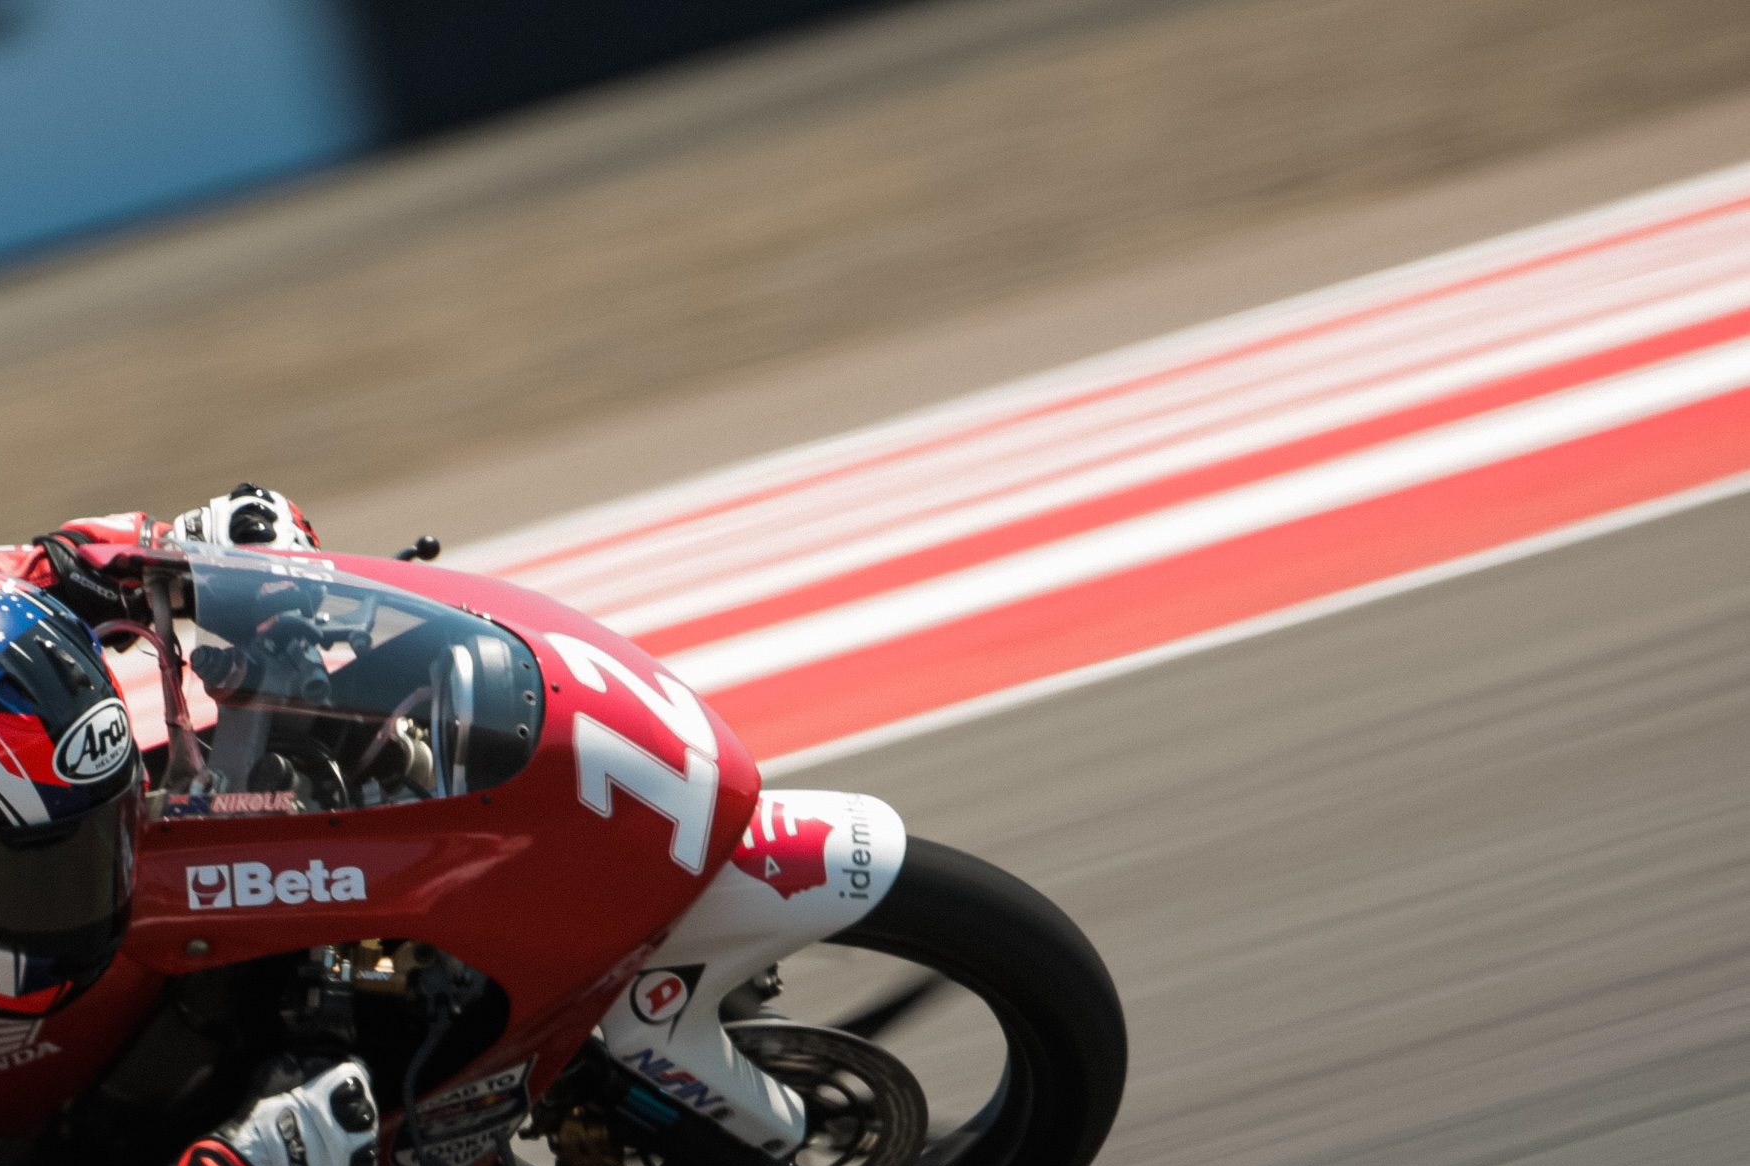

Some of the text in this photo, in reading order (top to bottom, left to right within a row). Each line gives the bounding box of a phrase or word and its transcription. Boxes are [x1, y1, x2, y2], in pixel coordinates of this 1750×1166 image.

[546, 631, 720, 876] 12
[232, 858, 368, 907] Beta
[839, 795, 872, 900] idemits
